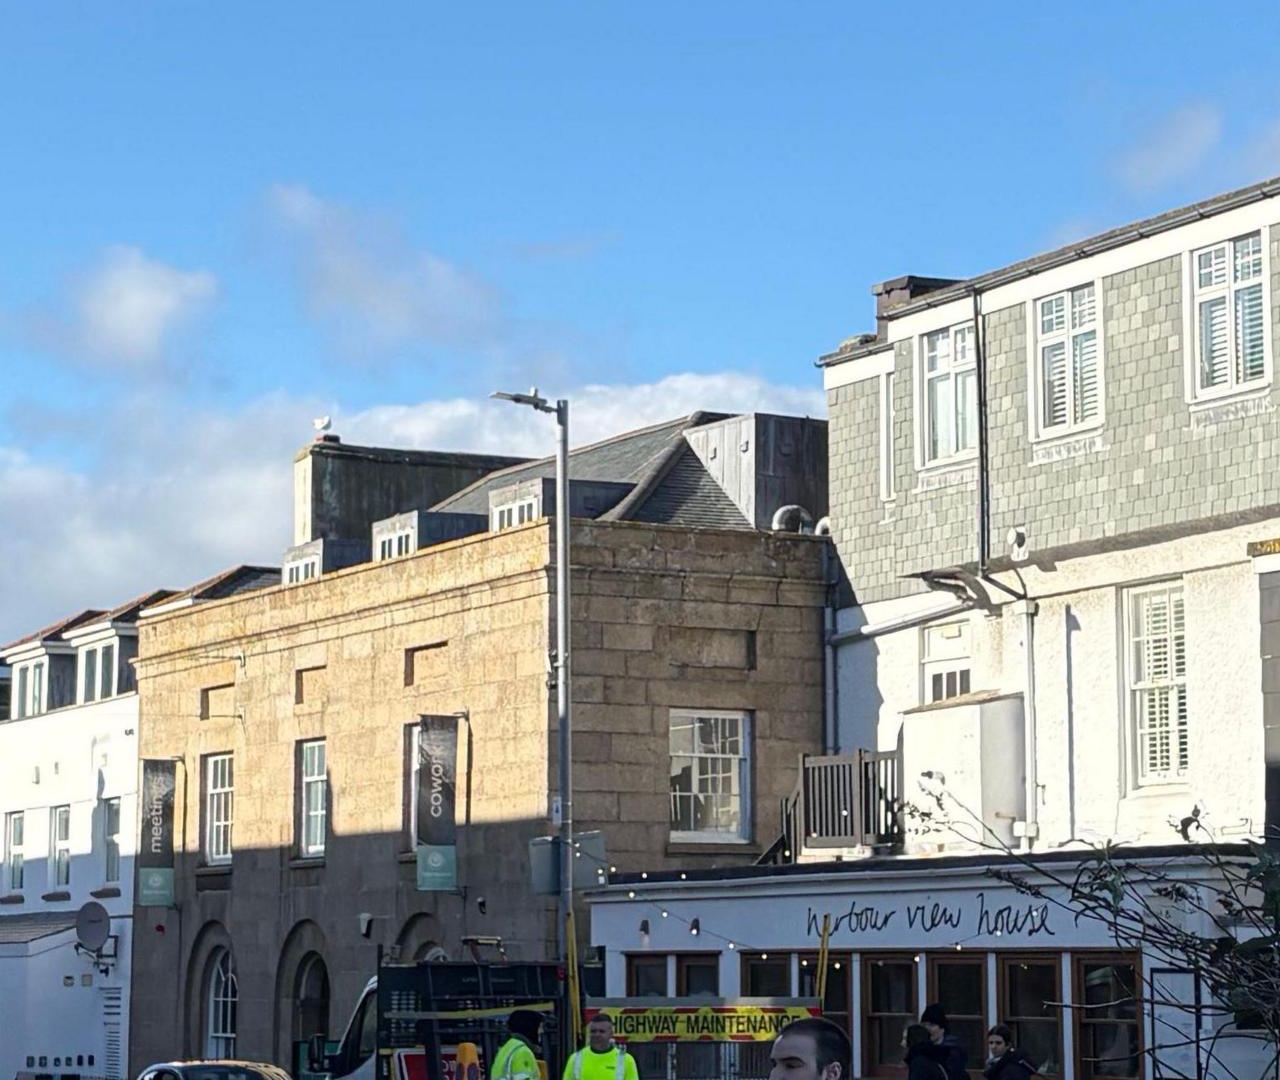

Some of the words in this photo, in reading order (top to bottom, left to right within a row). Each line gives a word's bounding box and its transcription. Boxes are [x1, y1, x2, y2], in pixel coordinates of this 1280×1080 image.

[149, 776, 166, 853] meetings
[807, 901, 897, 937] hrbour
[907, 895, 962, 933] view
[976, 892, 1055, 937] house
